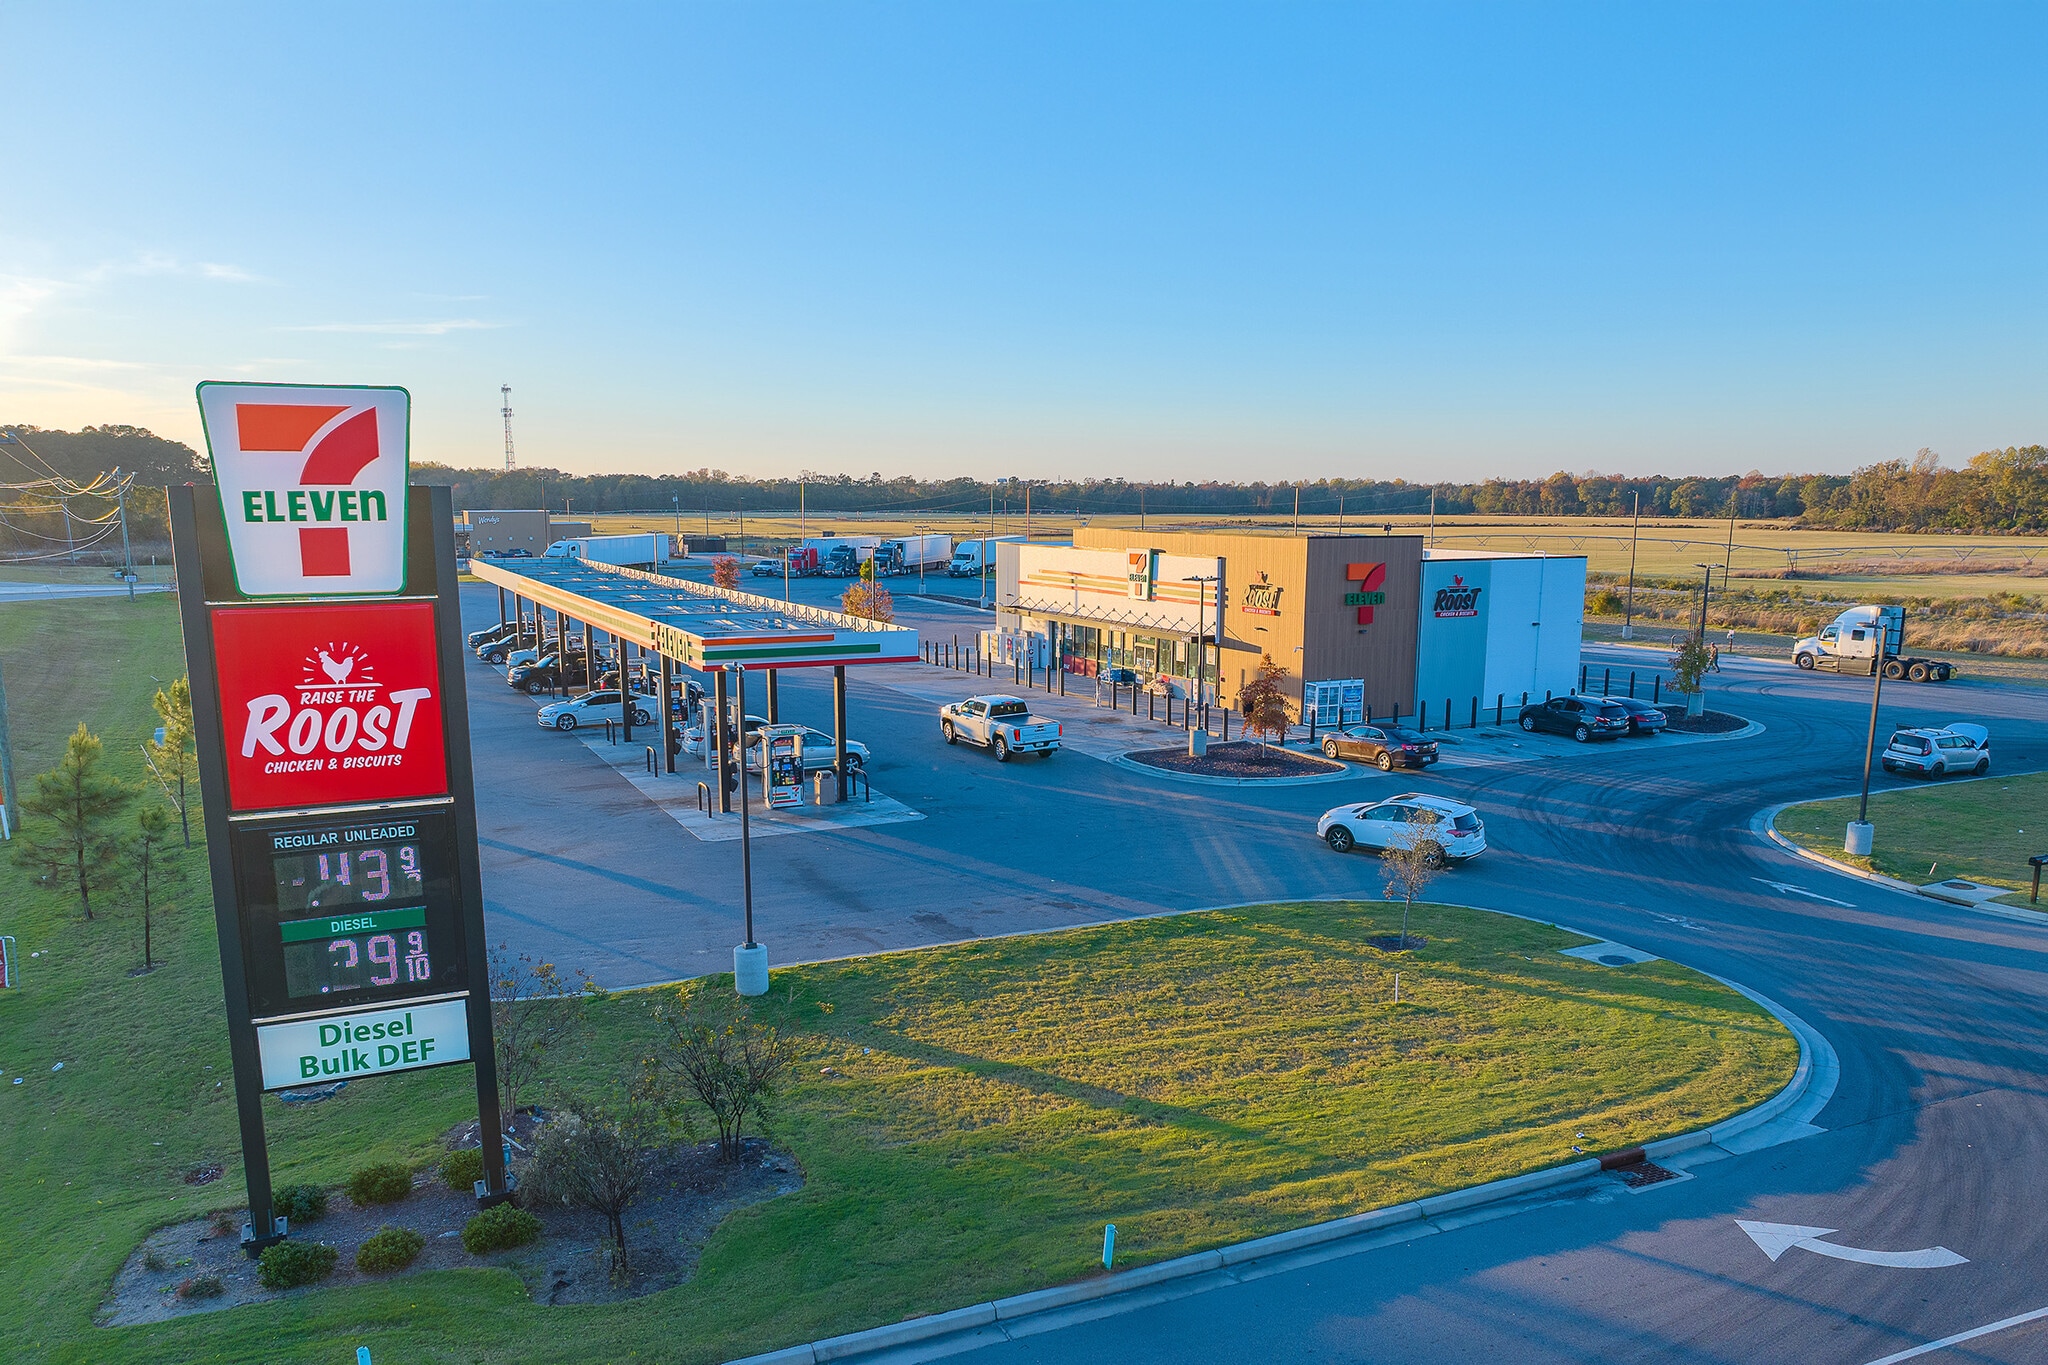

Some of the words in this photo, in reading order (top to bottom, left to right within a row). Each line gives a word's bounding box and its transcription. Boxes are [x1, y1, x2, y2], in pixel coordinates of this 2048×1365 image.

[236, 404, 379, 577] 7
[1347, 562, 1386, 625] 7
[1433, 587, 1482, 611] ROOST
[300, 690, 344, 704] RAISE
[349, 690, 375, 702] THE
[242, 688, 431, 759] ROOST
[264, 758, 323, 775] CHICKEN
[328, 758, 338, 770] &
[343, 754, 402, 769] BISCUITS
[274, 832, 339, 849] REGULAR
[345, 825, 415, 843] UNLEADED
[331, 917, 377, 933] DIESEL
[319, 1013, 414, 1048] Diesel
[299, 1050, 376, 1079] Bulk
[378, 1038, 435, 1067] DEF
